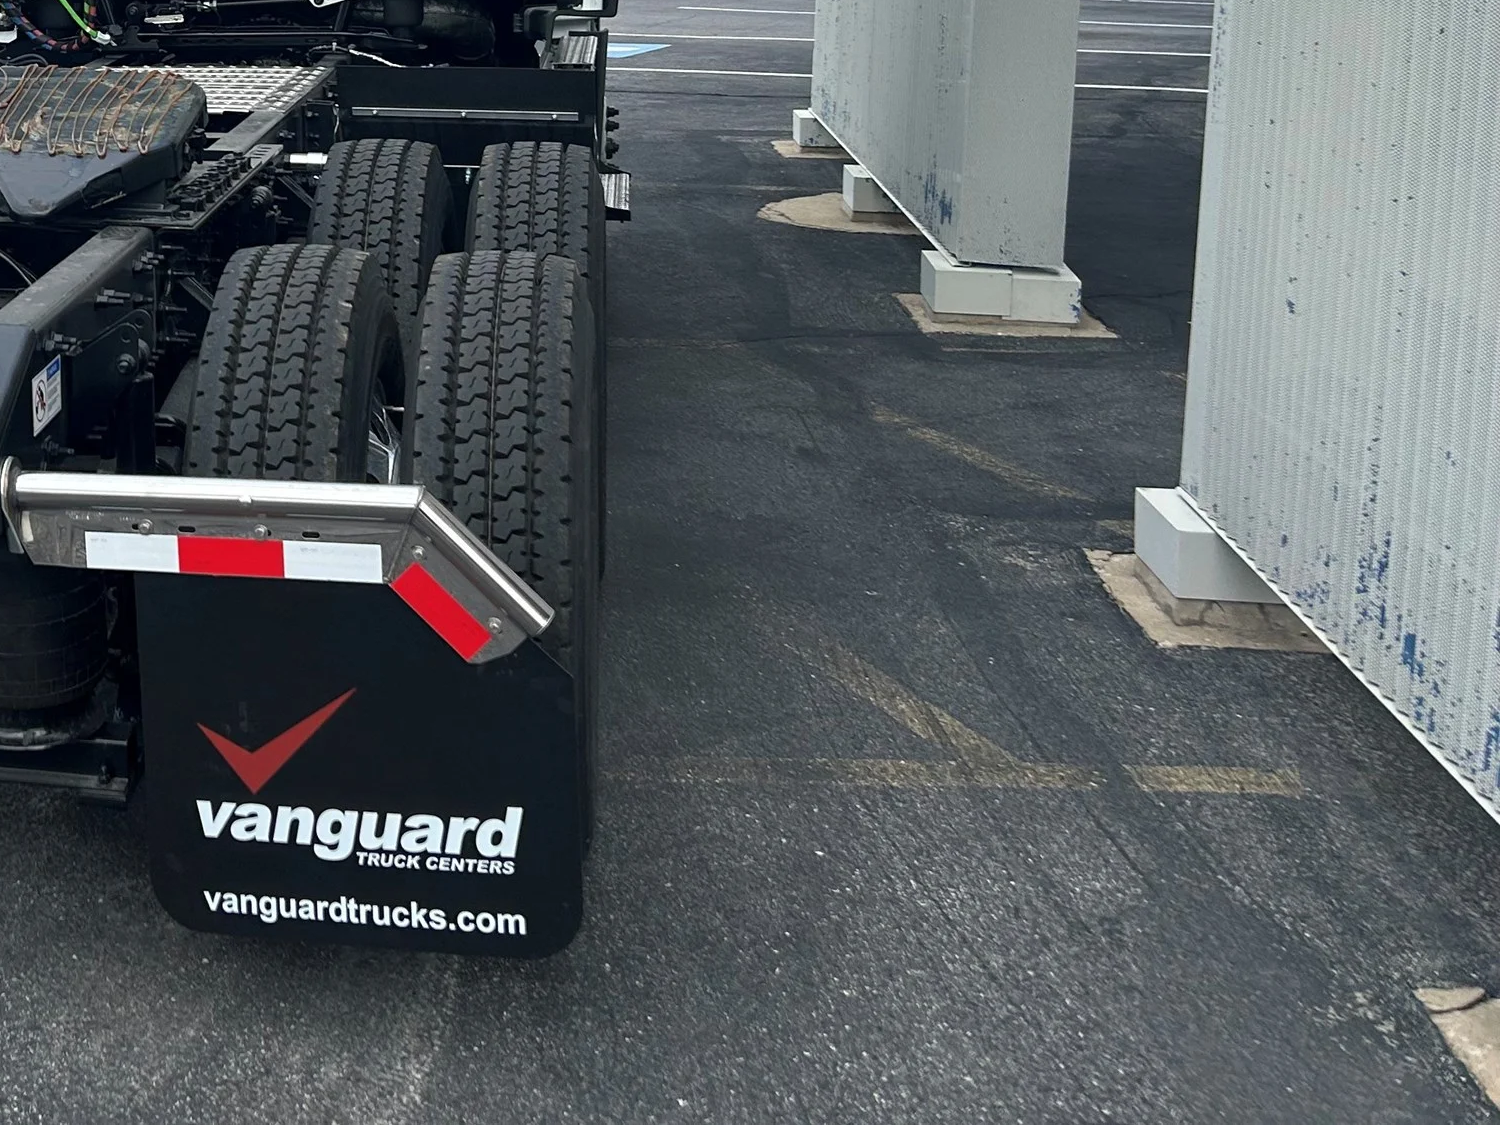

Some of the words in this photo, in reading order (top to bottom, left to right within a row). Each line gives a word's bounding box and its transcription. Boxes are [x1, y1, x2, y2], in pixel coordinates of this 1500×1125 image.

[195, 799, 524, 861] vanguard
[356, 851, 421, 870] TRUCK
[425, 856, 516, 875] CENTERS
[203, 889, 527, 935] vanguardtrucks.com
